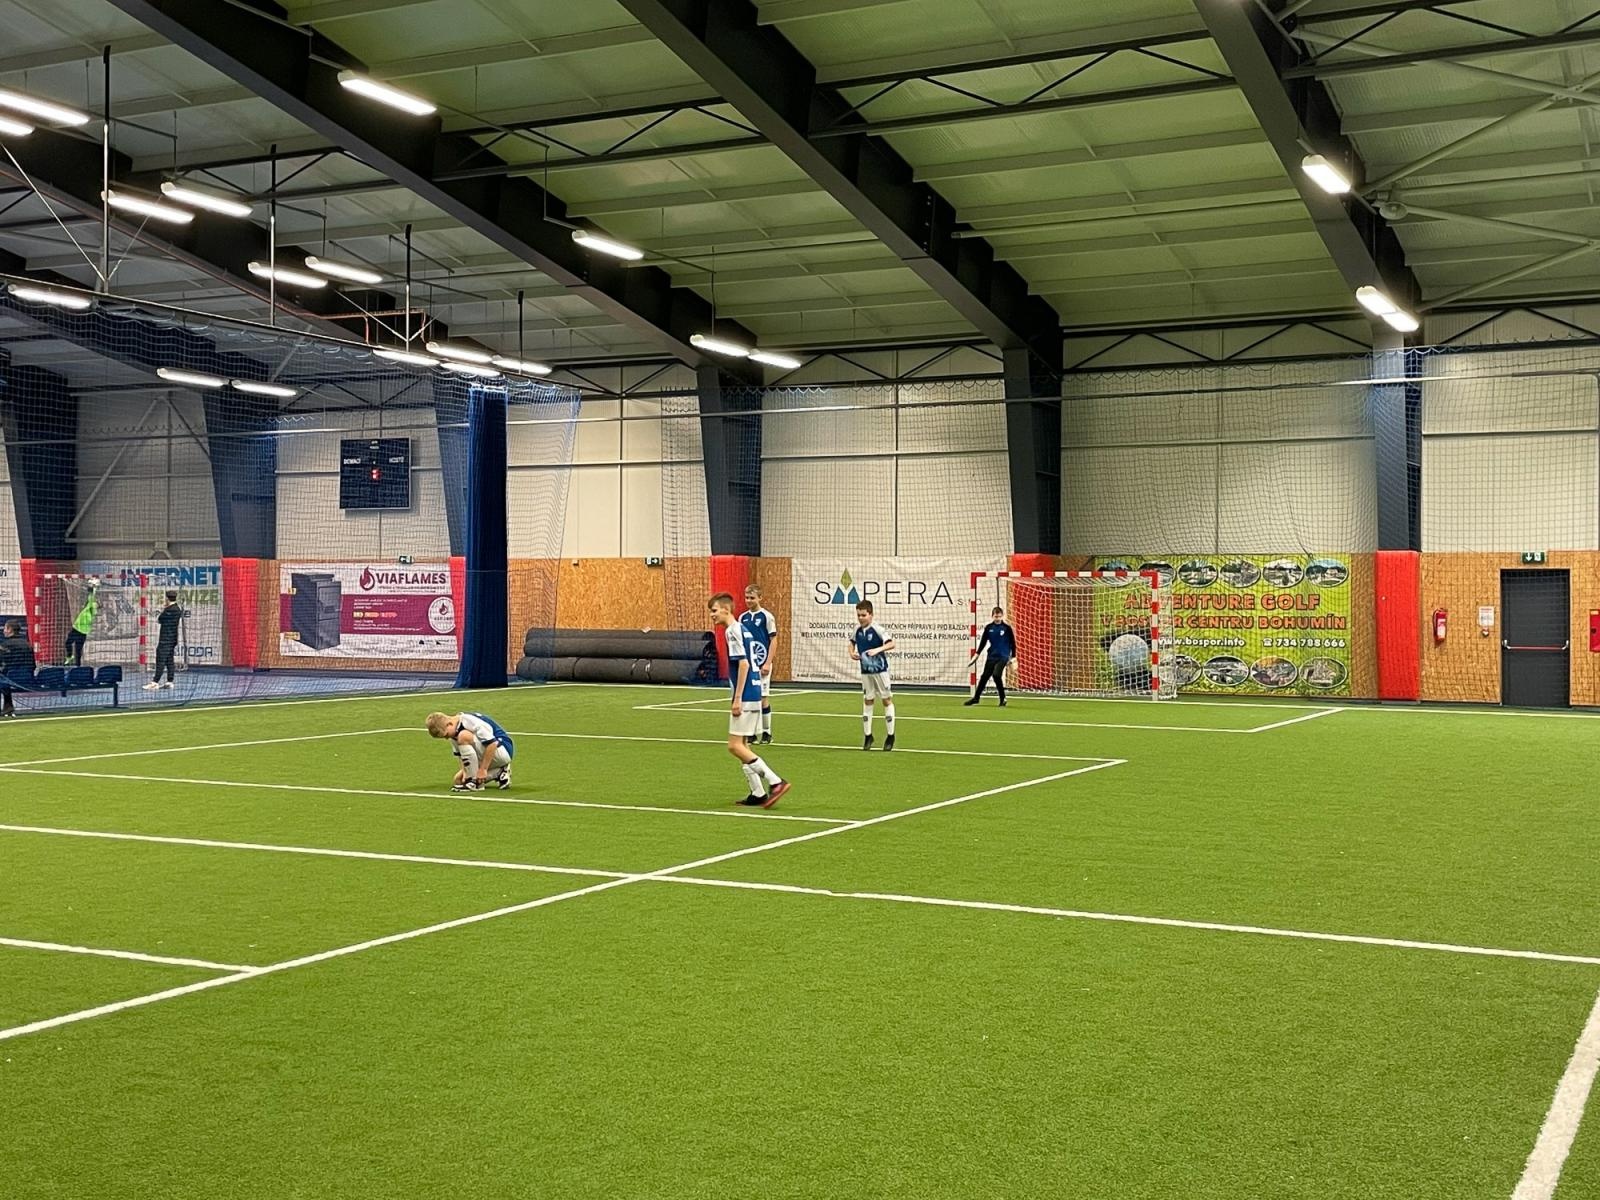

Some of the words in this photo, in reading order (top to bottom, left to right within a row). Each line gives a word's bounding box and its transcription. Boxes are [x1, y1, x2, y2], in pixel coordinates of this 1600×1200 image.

[120, 566, 220, 587] INTERNET
[376, 572, 446, 584] VIAFLAMES
[1261, 594, 1320, 610] GOLF
[1115, 615, 1184, 628] BOSOR
[1187, 615, 1254, 628] CENTRU
[1258, 613, 1346, 629] BOHUMÍN
[1276, 638, 1297, 647] 734
[1324, 638, 1346, 648] 666
